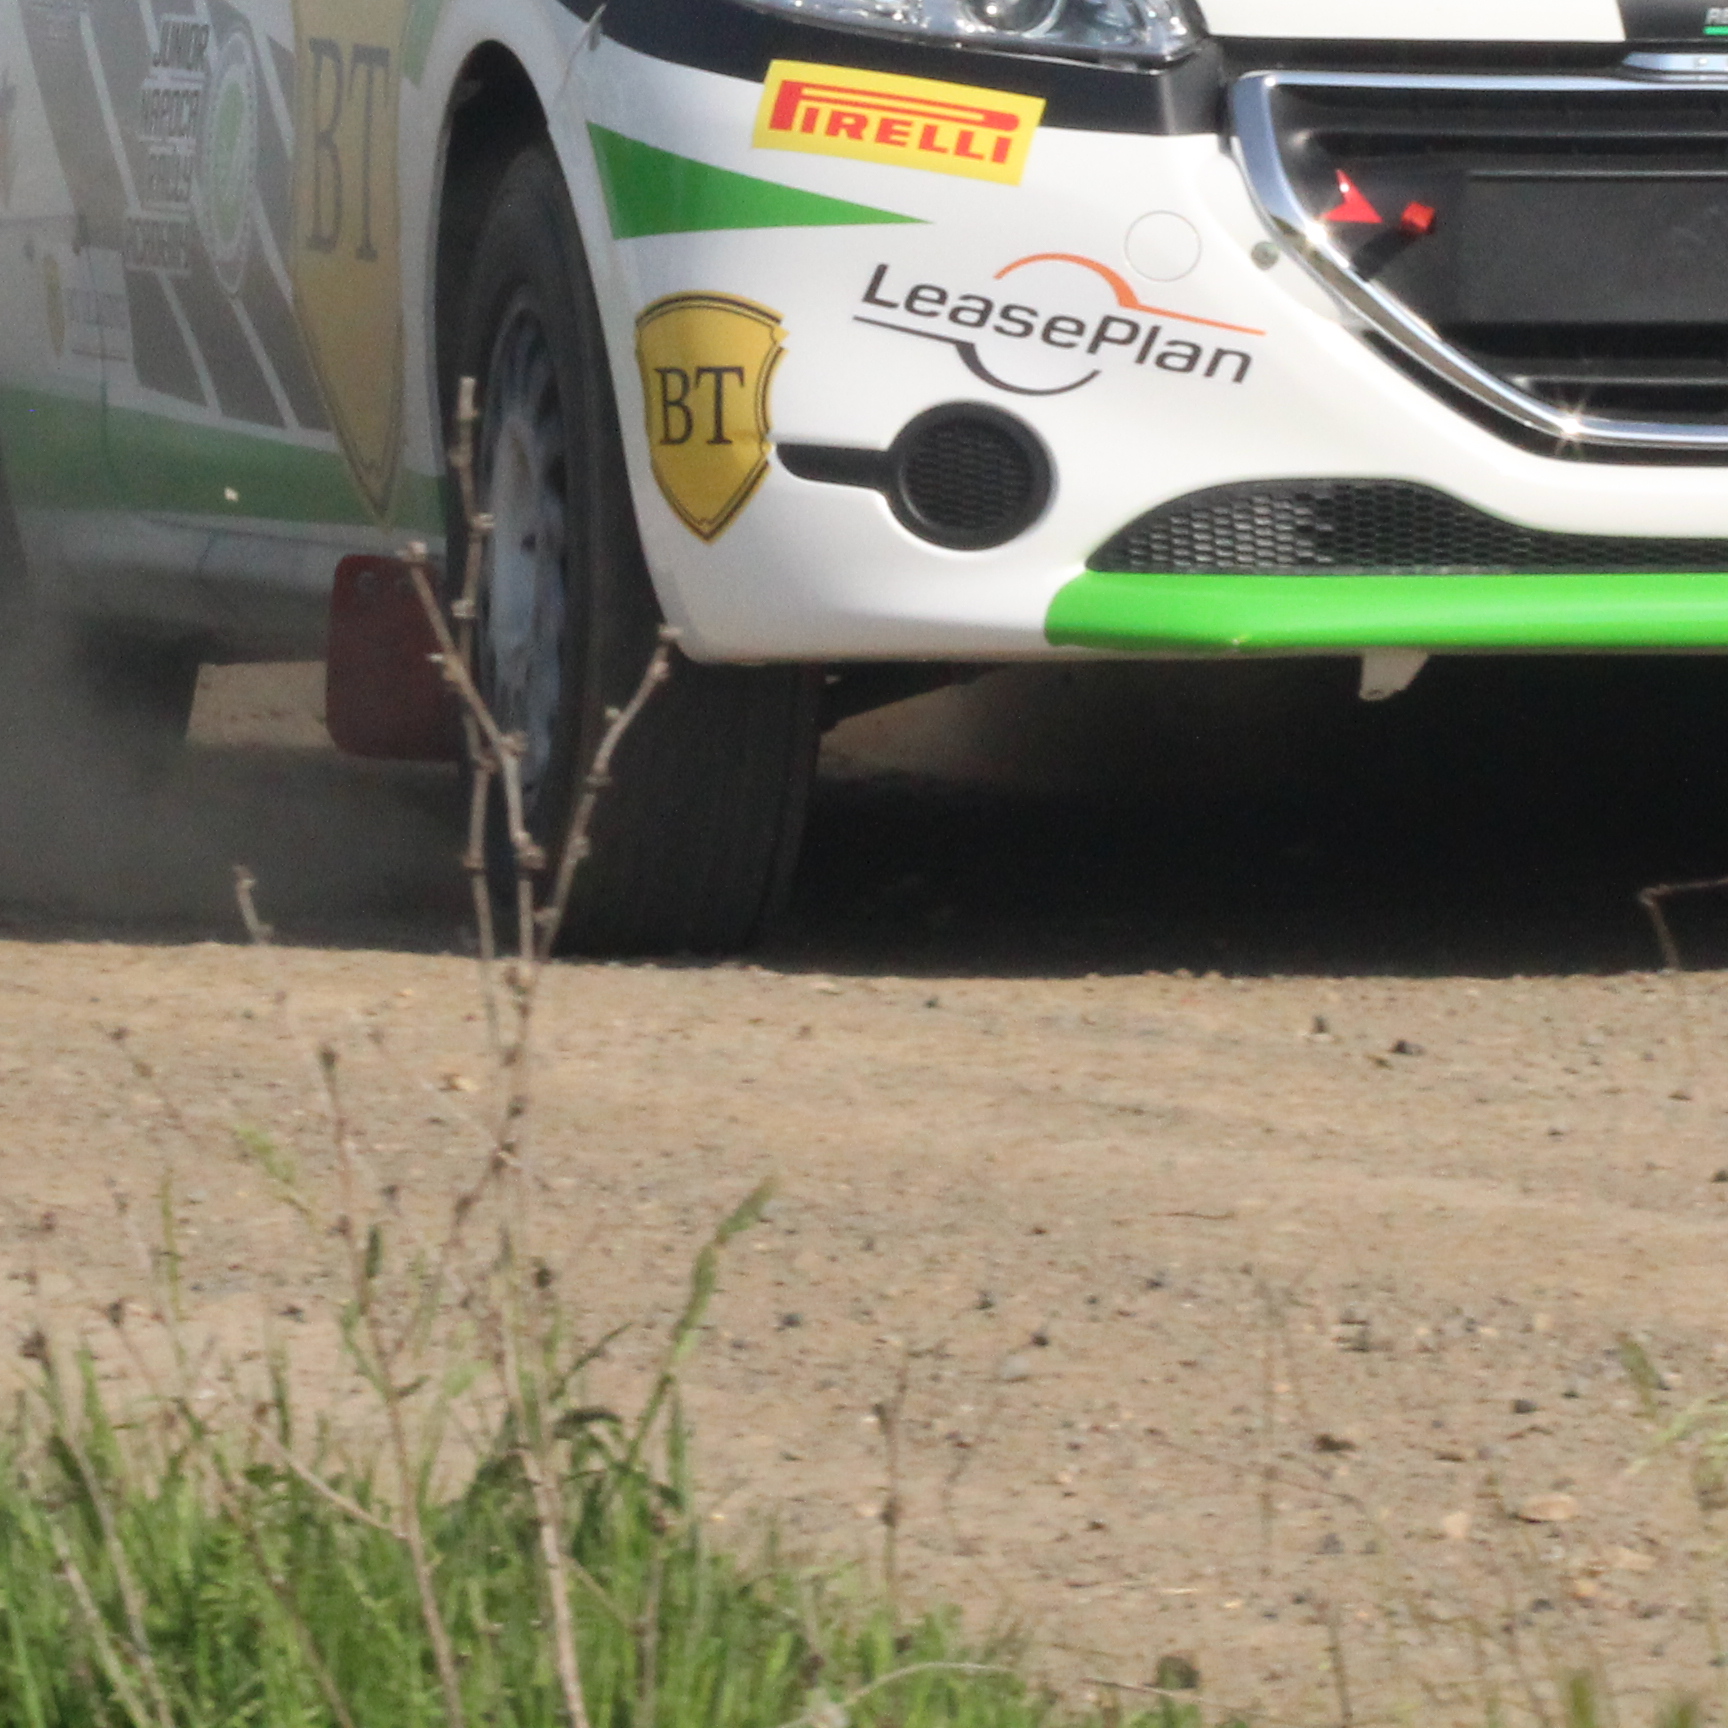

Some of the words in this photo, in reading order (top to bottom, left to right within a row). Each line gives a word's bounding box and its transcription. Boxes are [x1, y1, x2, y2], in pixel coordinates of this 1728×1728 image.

[308, 36, 392, 262] BT
[770, 79, 1020, 164] PIRELLI
[862, 263, 1253, 384] LeasePlan
[654, 366, 745, 446] BT
